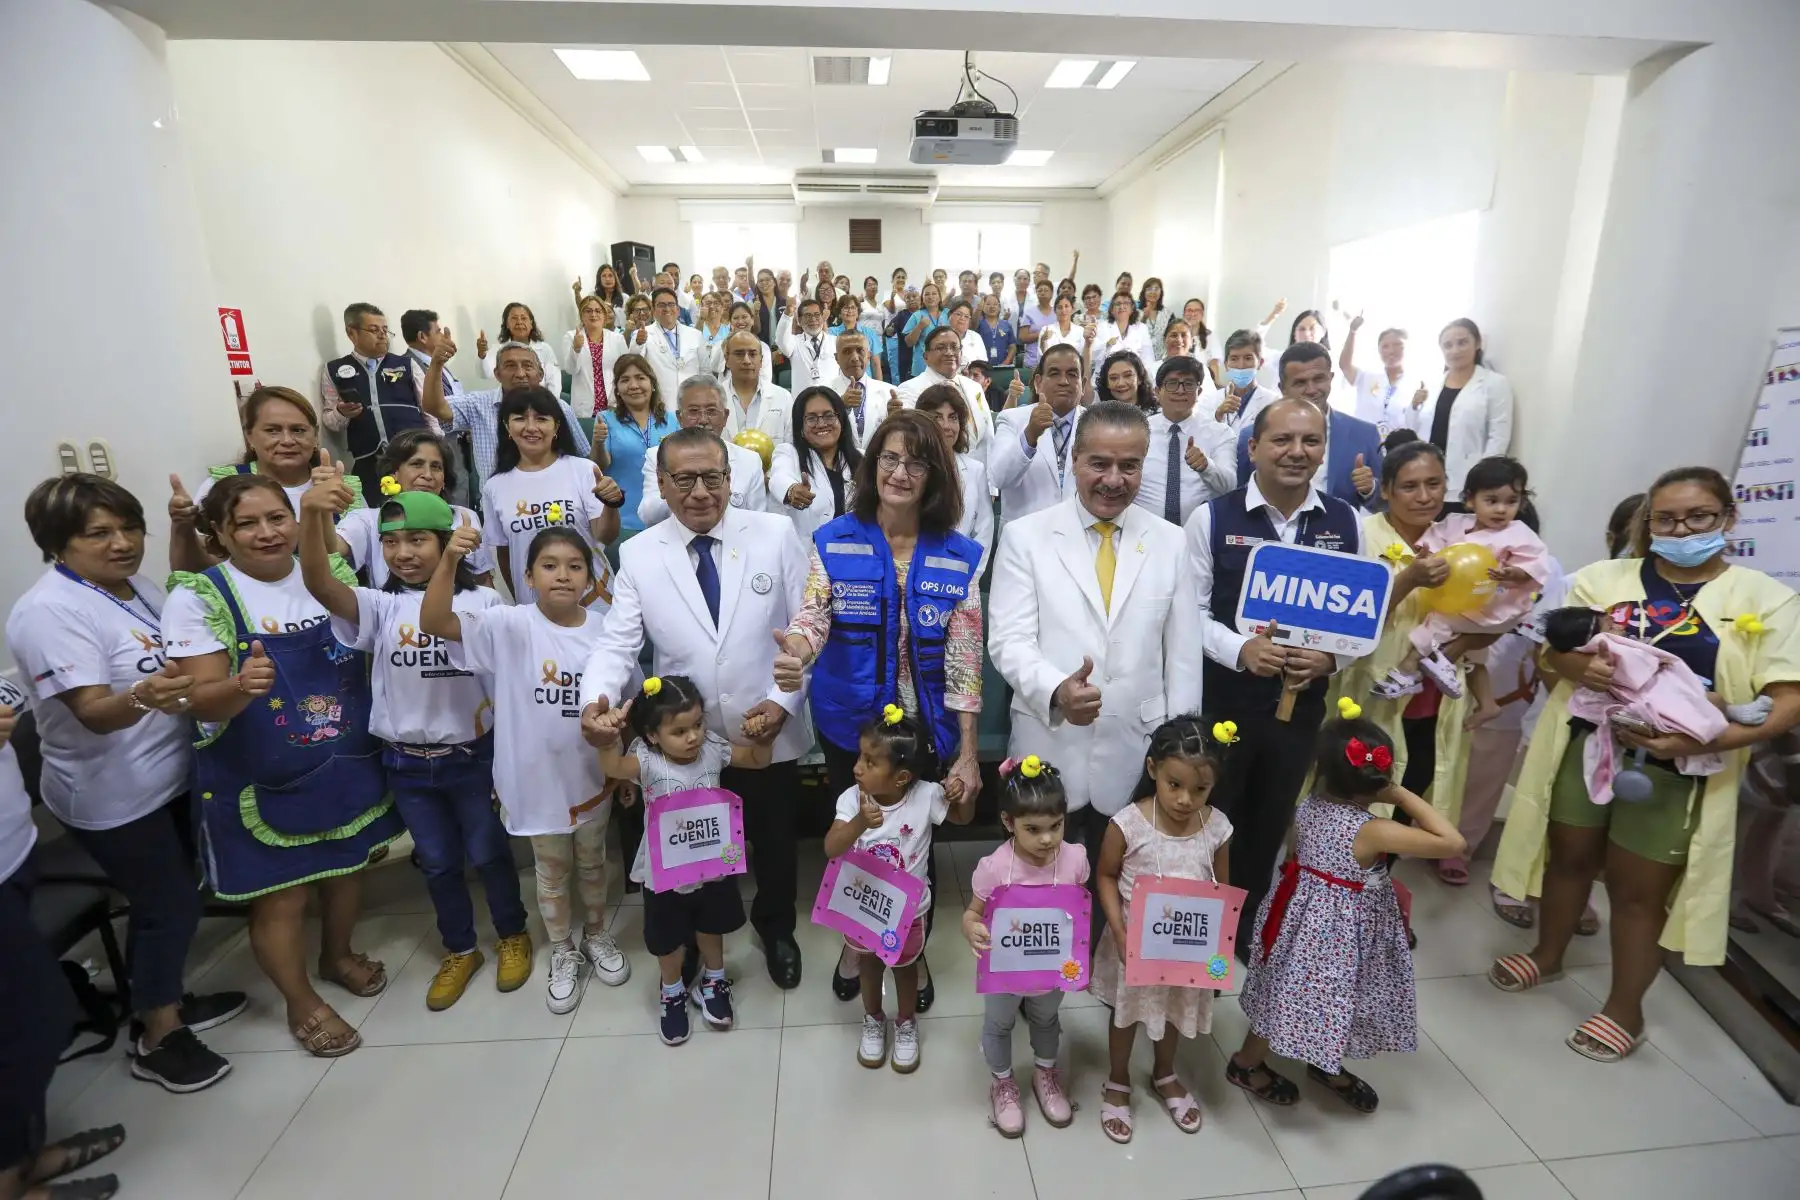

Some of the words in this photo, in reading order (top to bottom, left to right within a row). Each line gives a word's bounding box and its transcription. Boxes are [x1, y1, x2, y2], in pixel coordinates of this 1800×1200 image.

[510, 513, 575, 533] CUEA
[921, 581, 939, 592] OPS
[946, 584, 964, 596] OMS
[1249, 570, 1377, 620] MINSA
[390, 650, 449, 667] CUEN
[561, 671, 583, 687] DA
[686, 817, 720, 831] DATE
[669, 827, 720, 846] CUENTA
[843, 886, 891, 920] CUENTA
[863, 884, 894, 909] DATE
[1174, 910, 1209, 926] DATE
[1022, 922, 1060, 935] DATE
[1152, 922, 1208, 938] CUENTA
[1000, 935, 1060, 948] CUENTA
